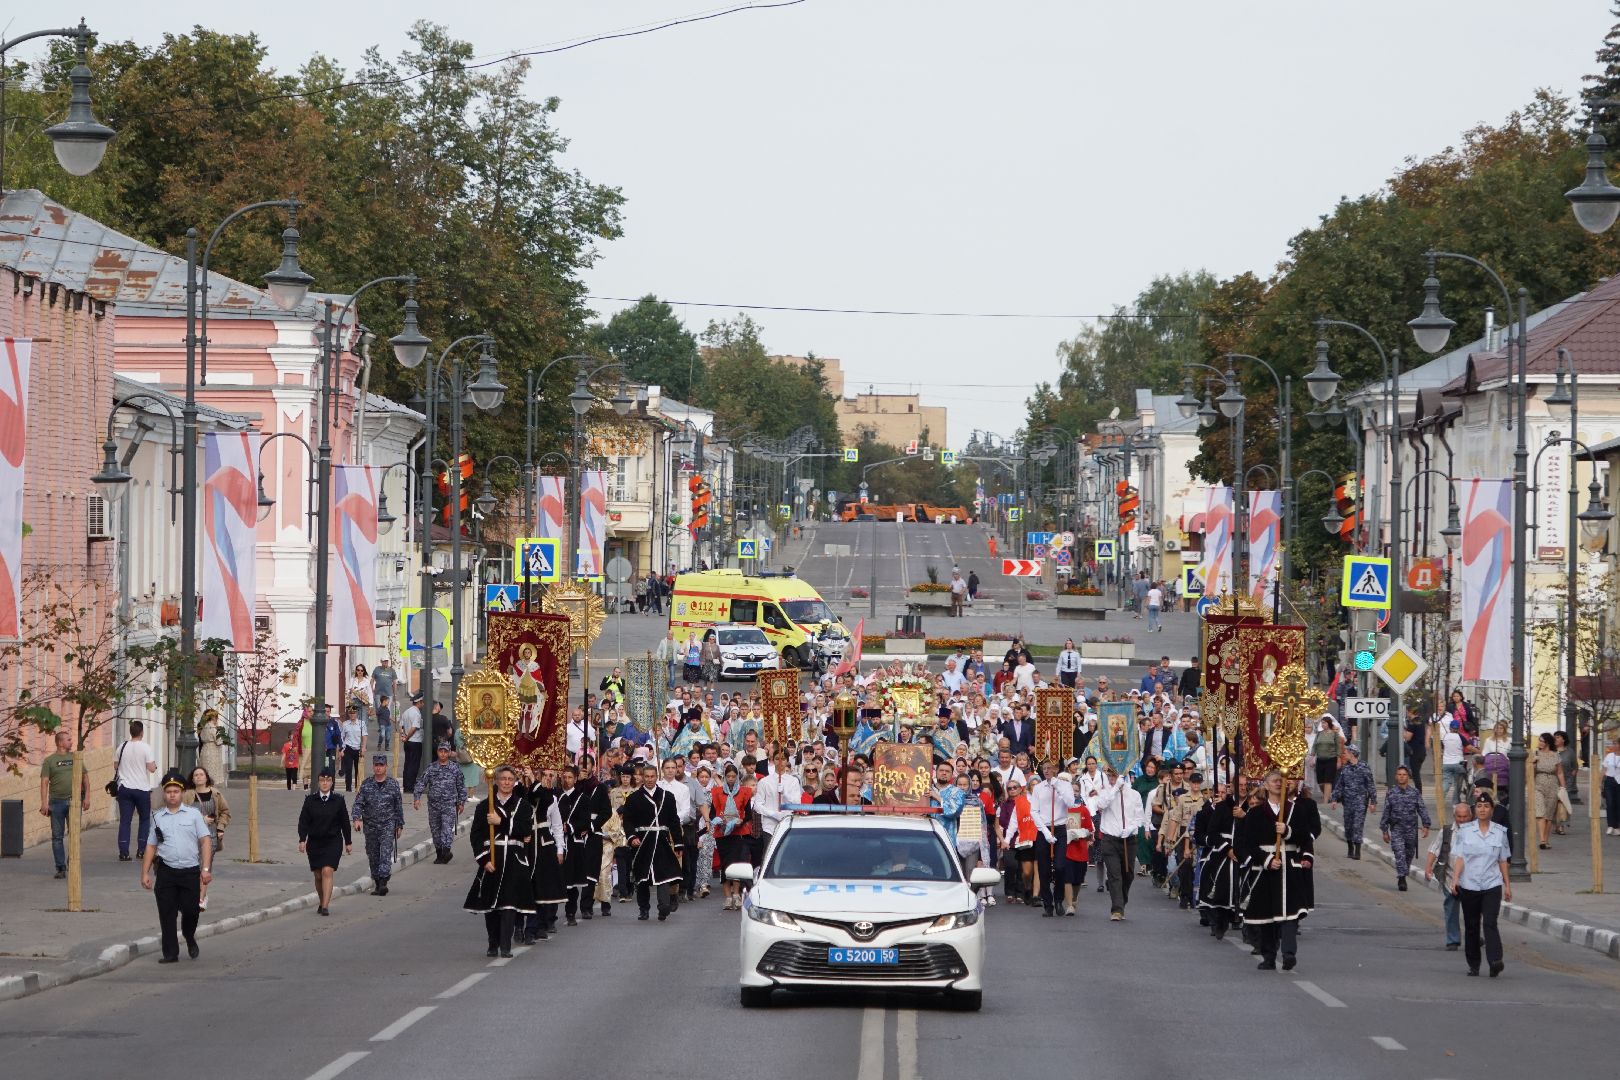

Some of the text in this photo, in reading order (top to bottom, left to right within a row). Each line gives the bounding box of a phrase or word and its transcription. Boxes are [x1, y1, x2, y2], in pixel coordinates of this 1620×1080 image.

[1415, 568, 1433, 587] Д
[698, 601, 714, 611] 112
[803, 884, 929, 896] ДПС
[846, 949, 876, 962] 5200
[882, 950, 894, 959] 50
